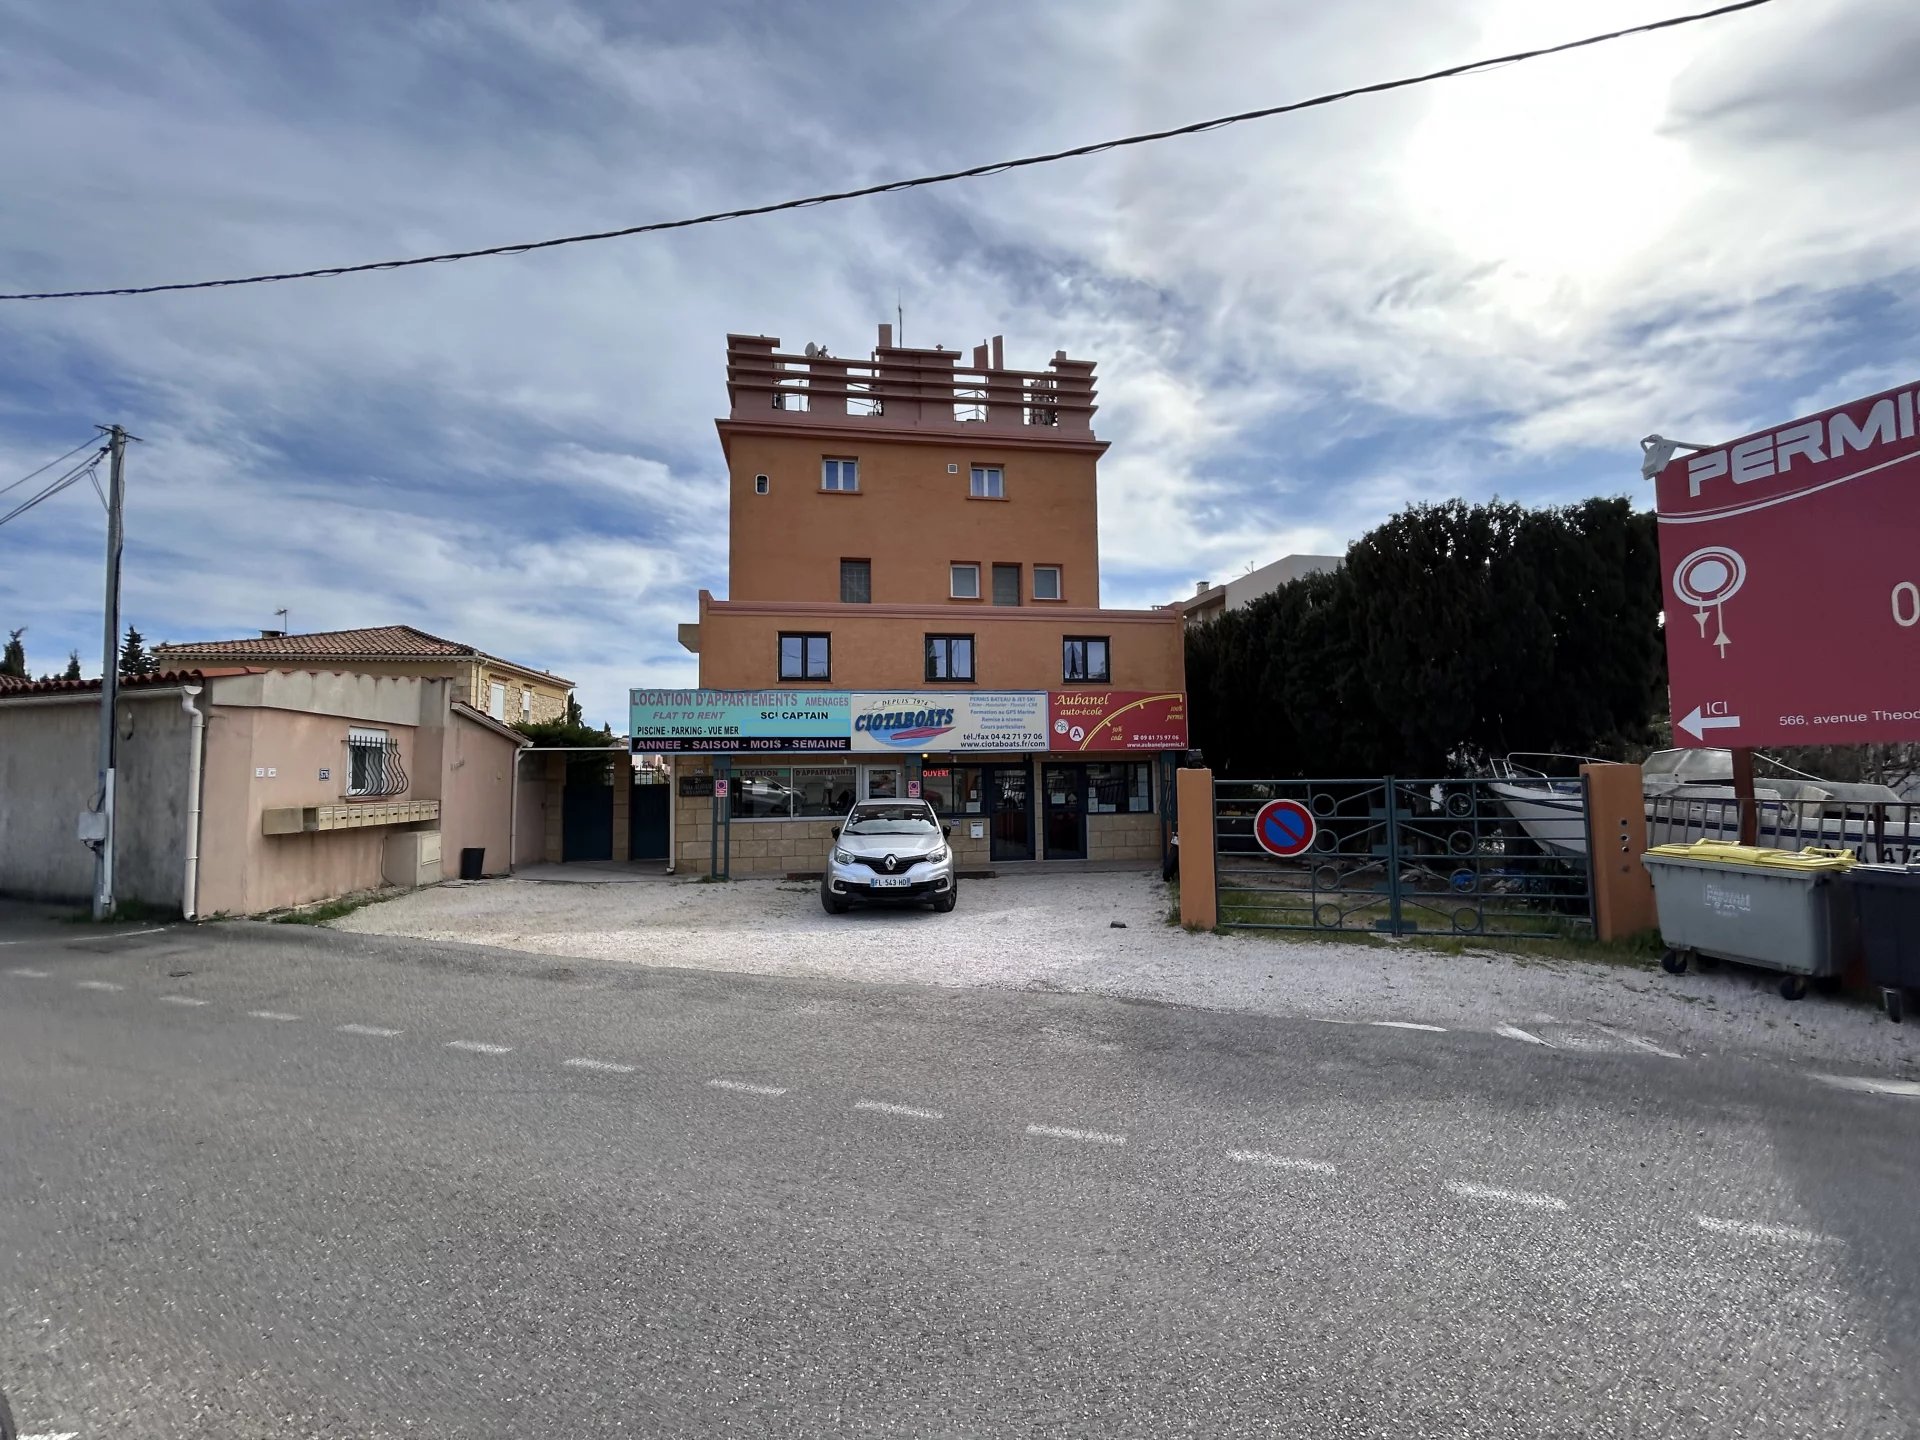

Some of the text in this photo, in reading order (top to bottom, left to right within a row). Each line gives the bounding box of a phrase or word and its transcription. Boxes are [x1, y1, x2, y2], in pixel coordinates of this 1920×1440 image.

[1688, 390, 1920, 498] PERMI
[632, 692, 849, 707] LOCATION D'APPARTEMENTS AMÉNAGÉS
[882, 698, 909, 706] DEPUIS
[1054, 692, 1112, 705] Aubanel
[1060, 707, 1103, 716] auto-école
[1706, 701, 1728, 715] ICI
[652, 711, 726, 719] FLAT TO RENT
[781, 711, 829, 720] CAPTAIN
[1813, 712, 1868, 724] avenue
[855, 708, 954, 732] CIOTABOATS
[637, 726, 666, 735] PISCINE
[671, 726, 703, 735] PARKING
[708, 726, 723, 735] VUE
[724, 726, 739, 735] MER
[1072, 728, 1082, 739] A
[963, 732, 990, 741] tél./fax
[637, 740, 682, 750] ANNEE
[692, 740, 739, 749] SAISON
[750, 740, 781, 749] MOIS
[792, 739, 846, 748] SEMAINE
[960, 740, 1046, 748] www.ciotaboats.fr/com
[739, 769, 778, 777] LOCATION
[922, 769, 950, 778] OUVERT
